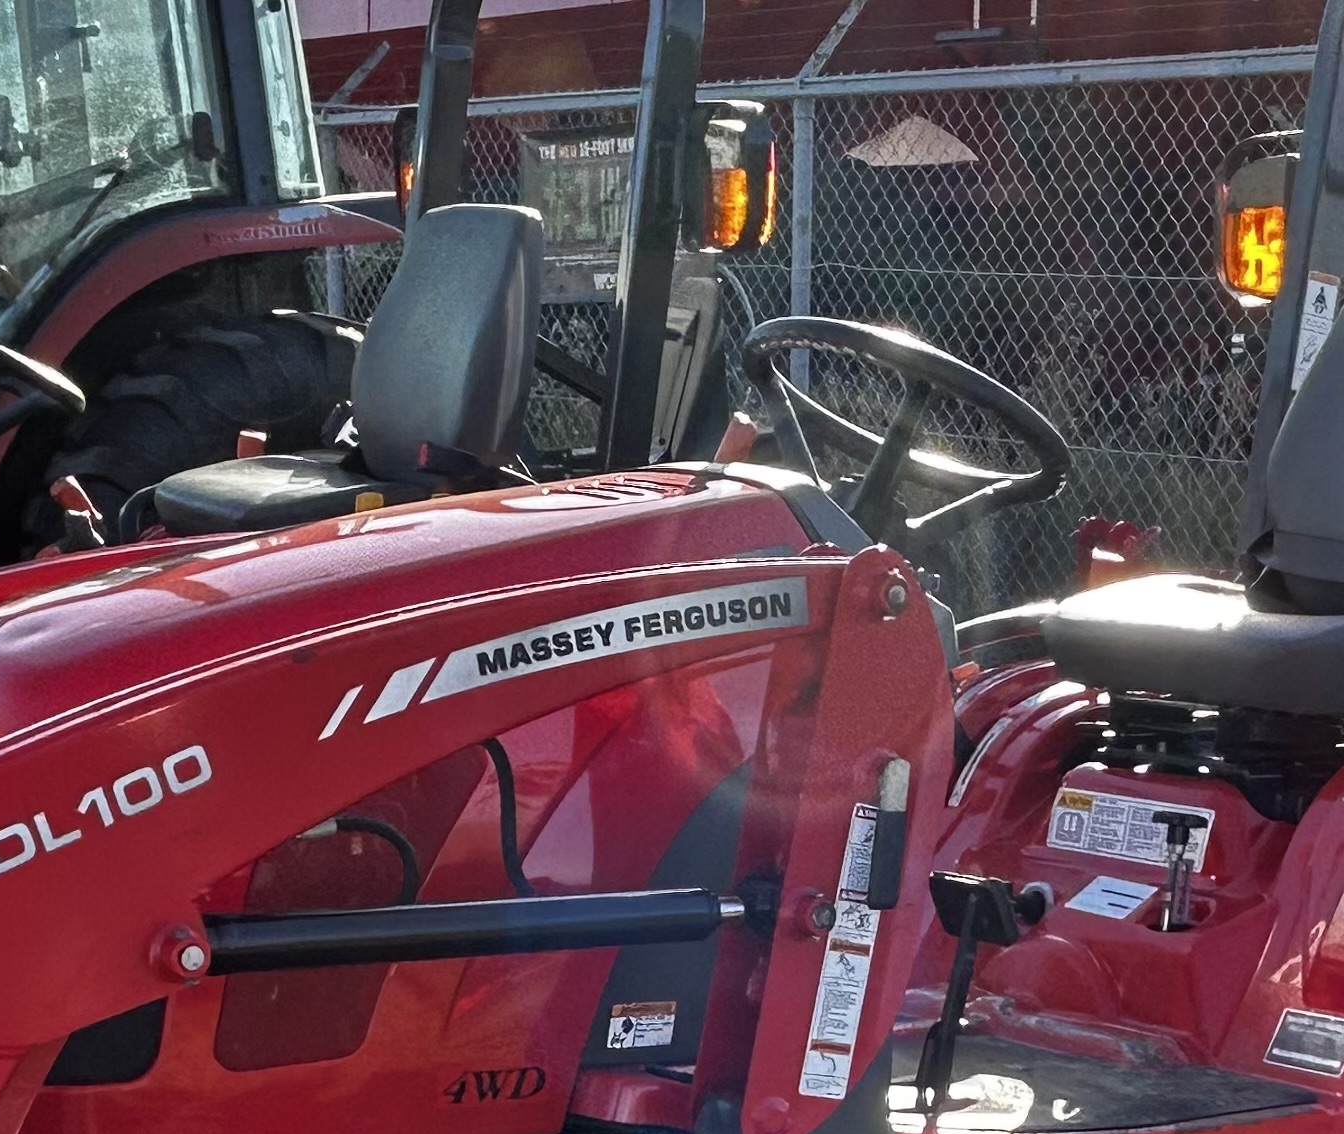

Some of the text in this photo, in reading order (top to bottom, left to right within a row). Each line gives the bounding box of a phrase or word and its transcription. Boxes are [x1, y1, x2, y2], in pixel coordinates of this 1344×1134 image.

[476, 592, 792, 677] MASSEY FERGUSON
[441, 1066, 547, 1105] 4WD
